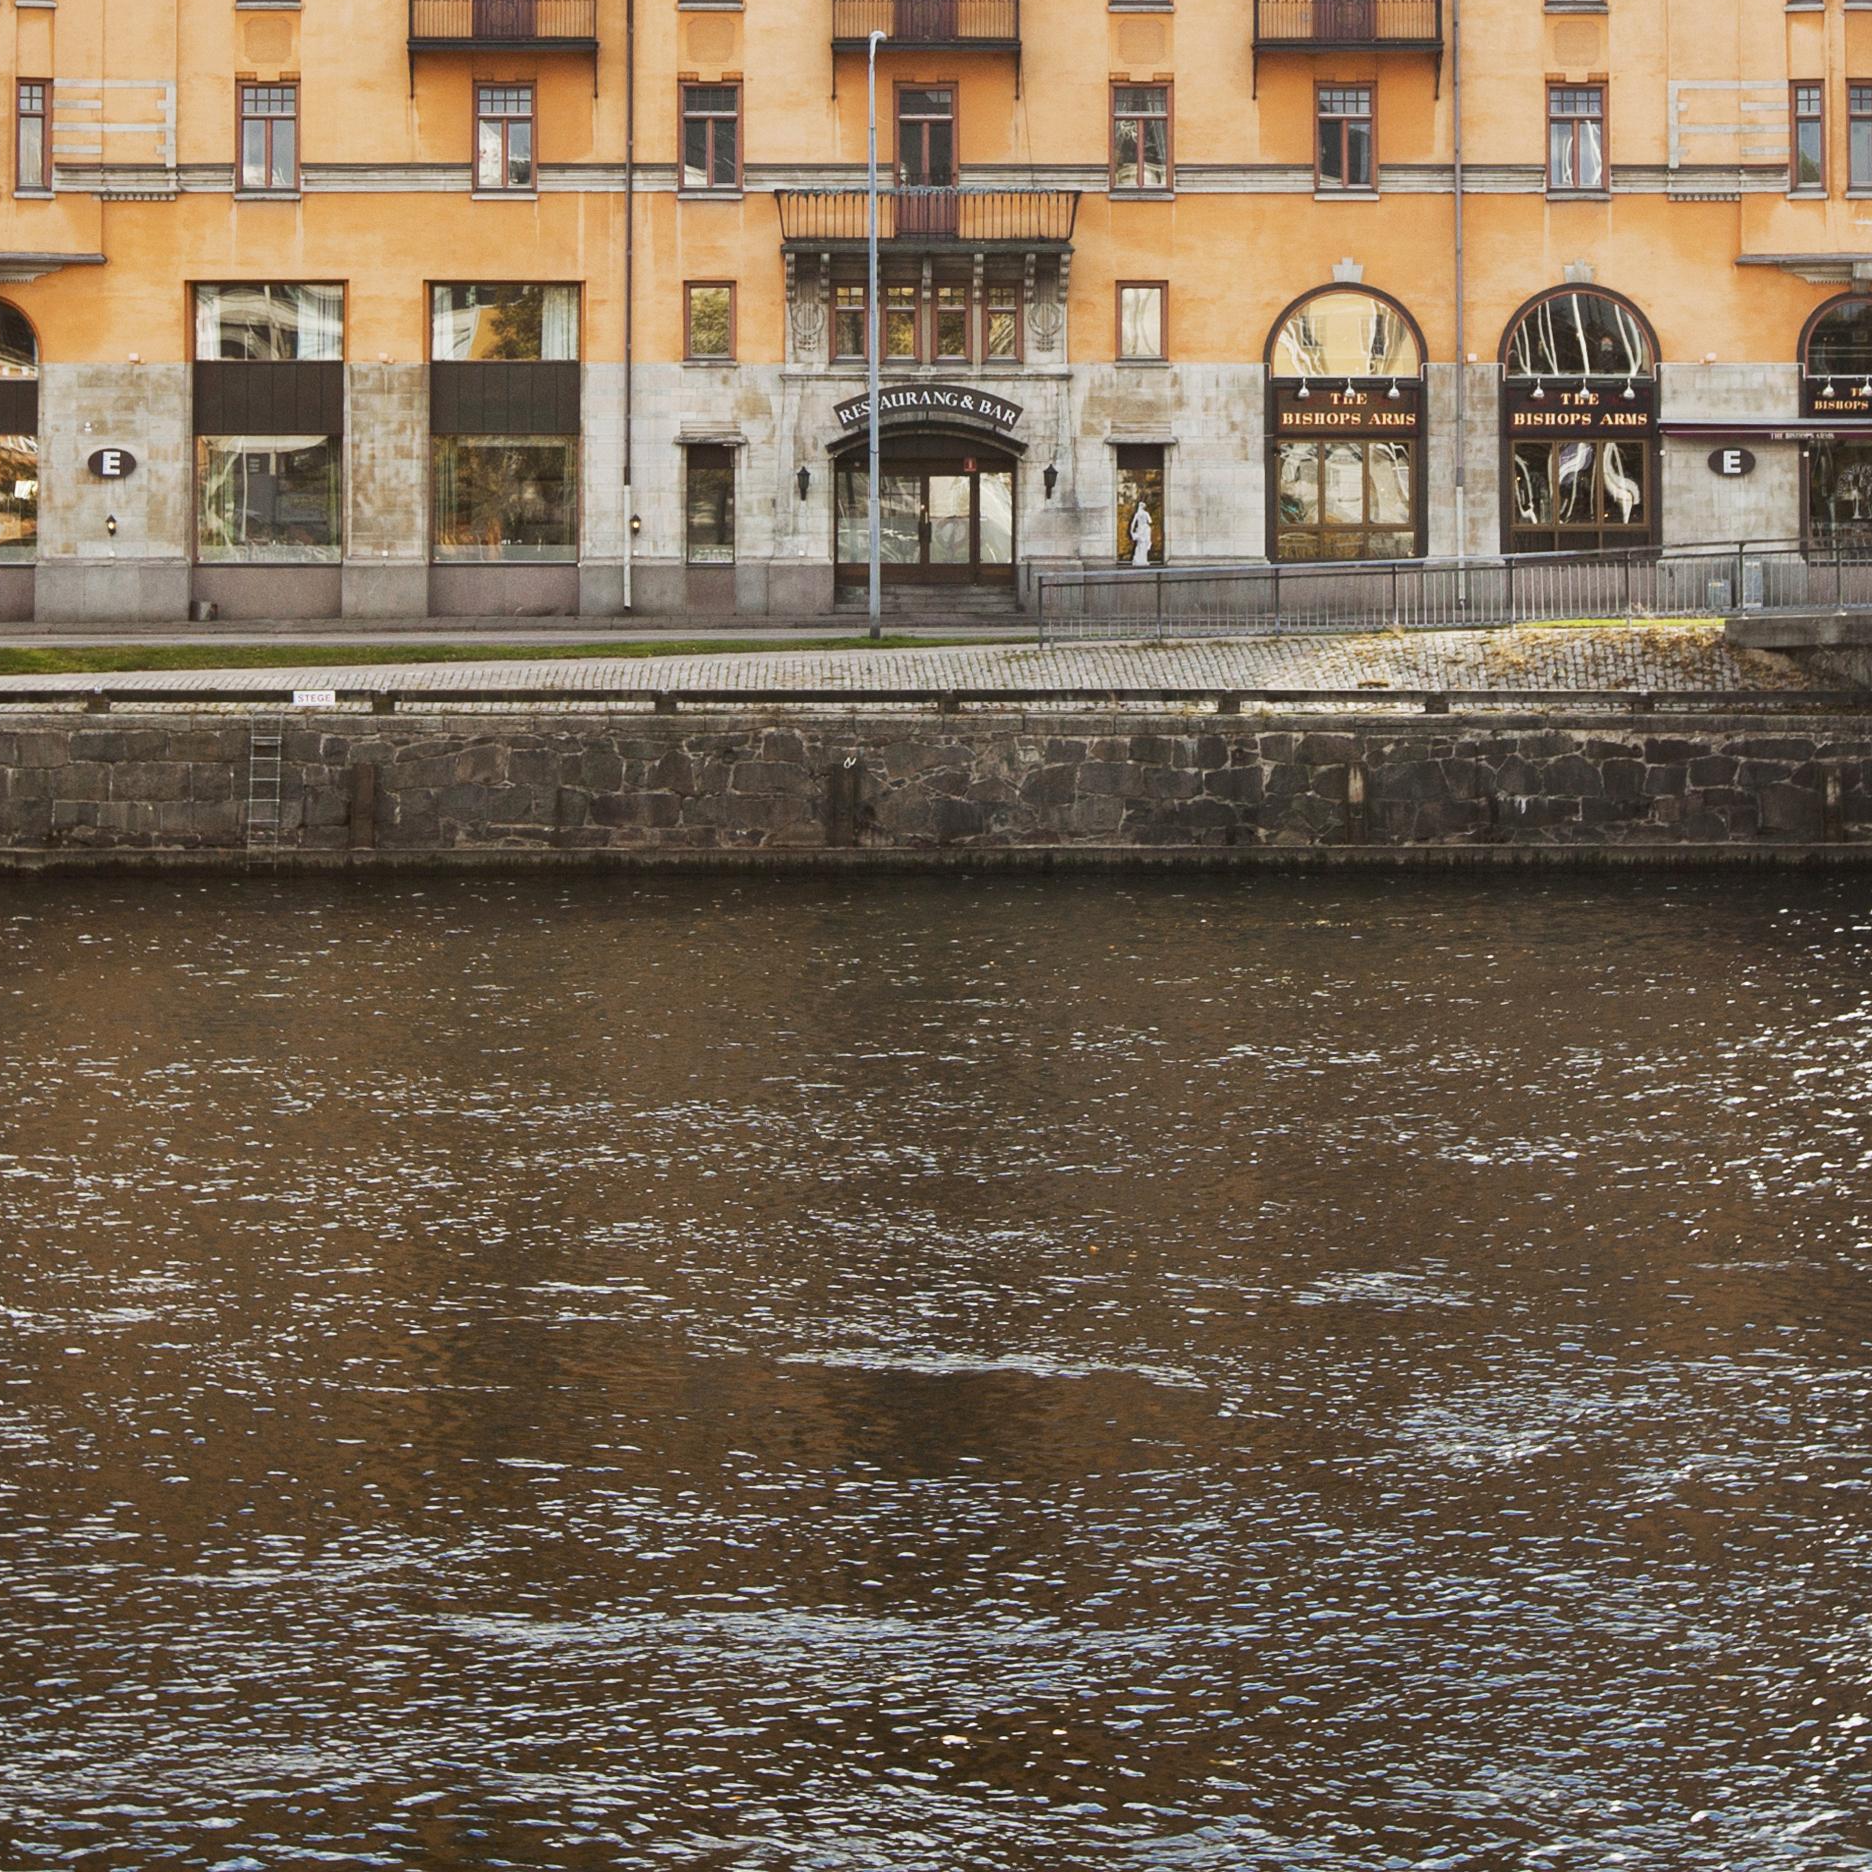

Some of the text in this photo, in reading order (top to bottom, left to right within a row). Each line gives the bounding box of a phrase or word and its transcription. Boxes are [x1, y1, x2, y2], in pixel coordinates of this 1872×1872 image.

[839, 391, 1017, 425] RESAURANG & BAR
[1814, 400, 1869, 410] BISHOPS
[1282, 412, 1416, 425] BISHOPS ARMS
[1514, 413, 1648, 425] BISHOPS ARMS
[102, 451, 121, 475] E
[1723, 450, 1741, 474] E
[298, 693, 331, 703] STEGE
